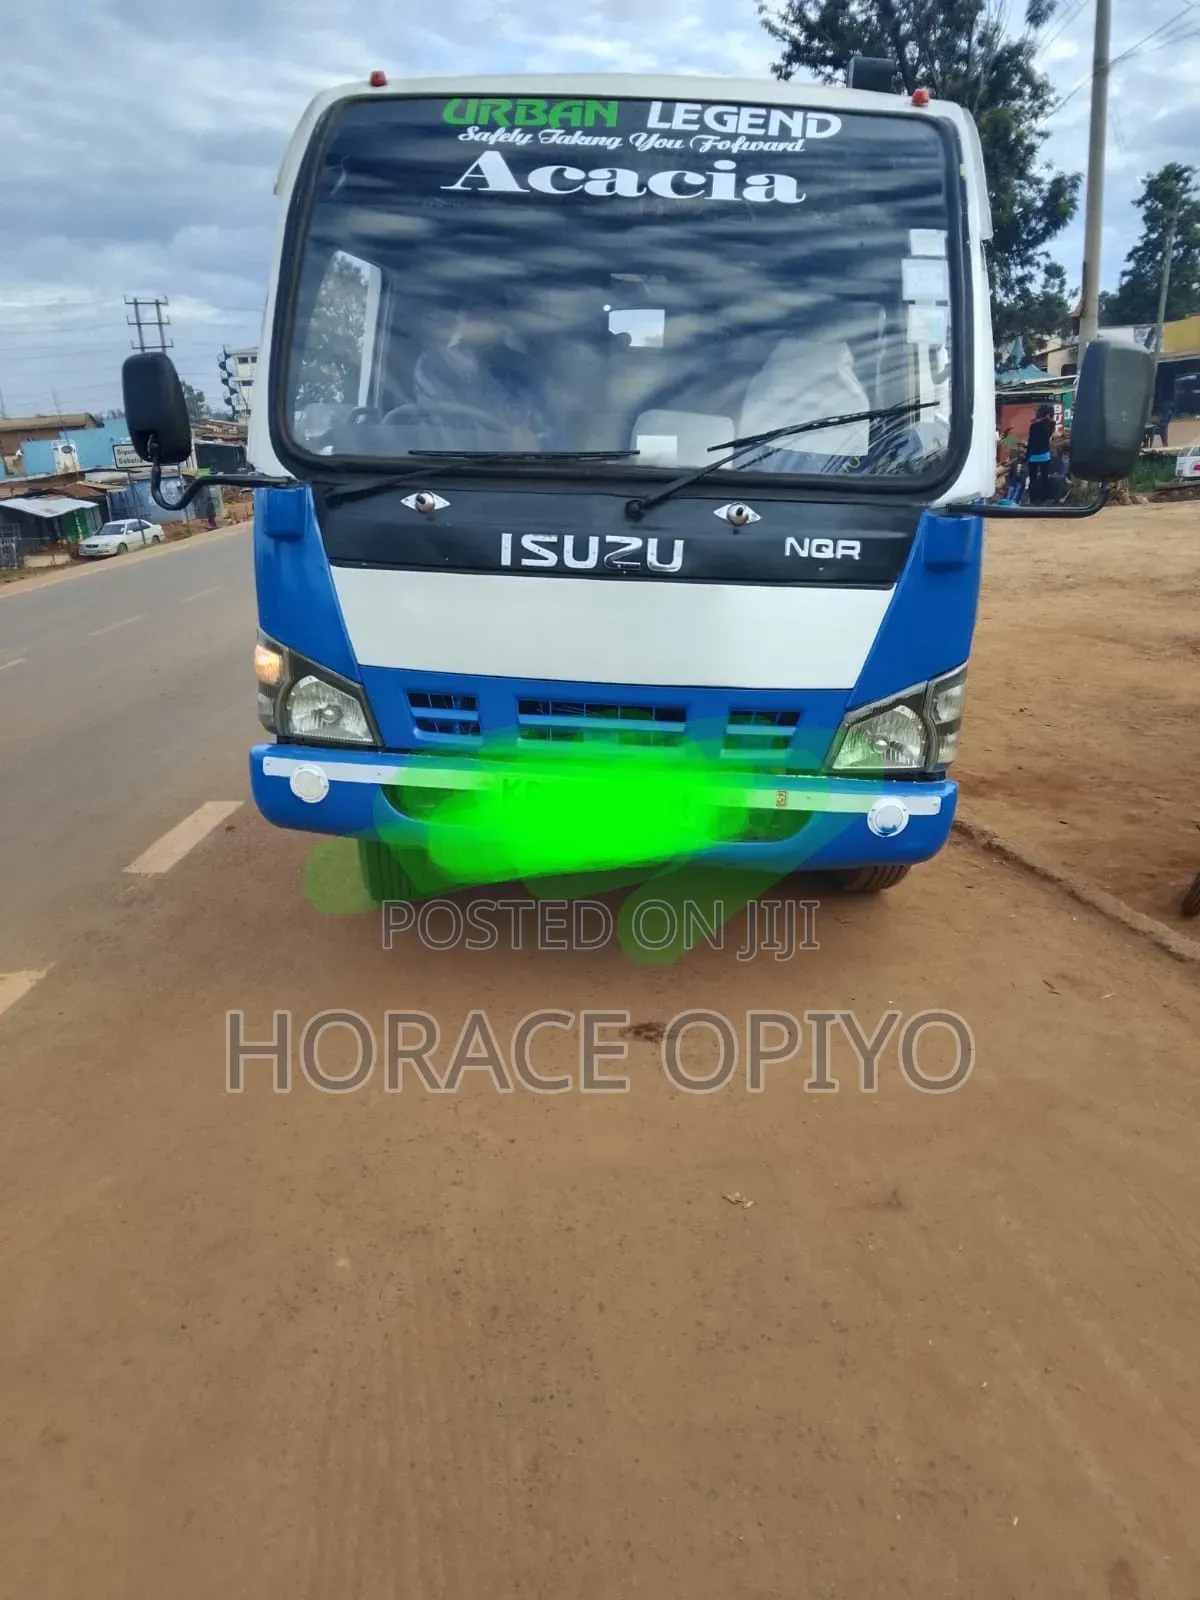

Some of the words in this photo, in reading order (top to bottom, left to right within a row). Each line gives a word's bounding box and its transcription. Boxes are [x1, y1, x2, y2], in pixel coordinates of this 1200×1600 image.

[442, 98, 618, 127] URBAN
[647, 101, 842, 139] LEGEND
[458, 126, 533, 145] Safely
[538, 129, 623, 150] Taking
[629, 132, 685, 151] You
[440, 150, 807, 203] Acacia
[501, 532, 685, 573] ISUZU
[785, 536, 862, 560] NQR
